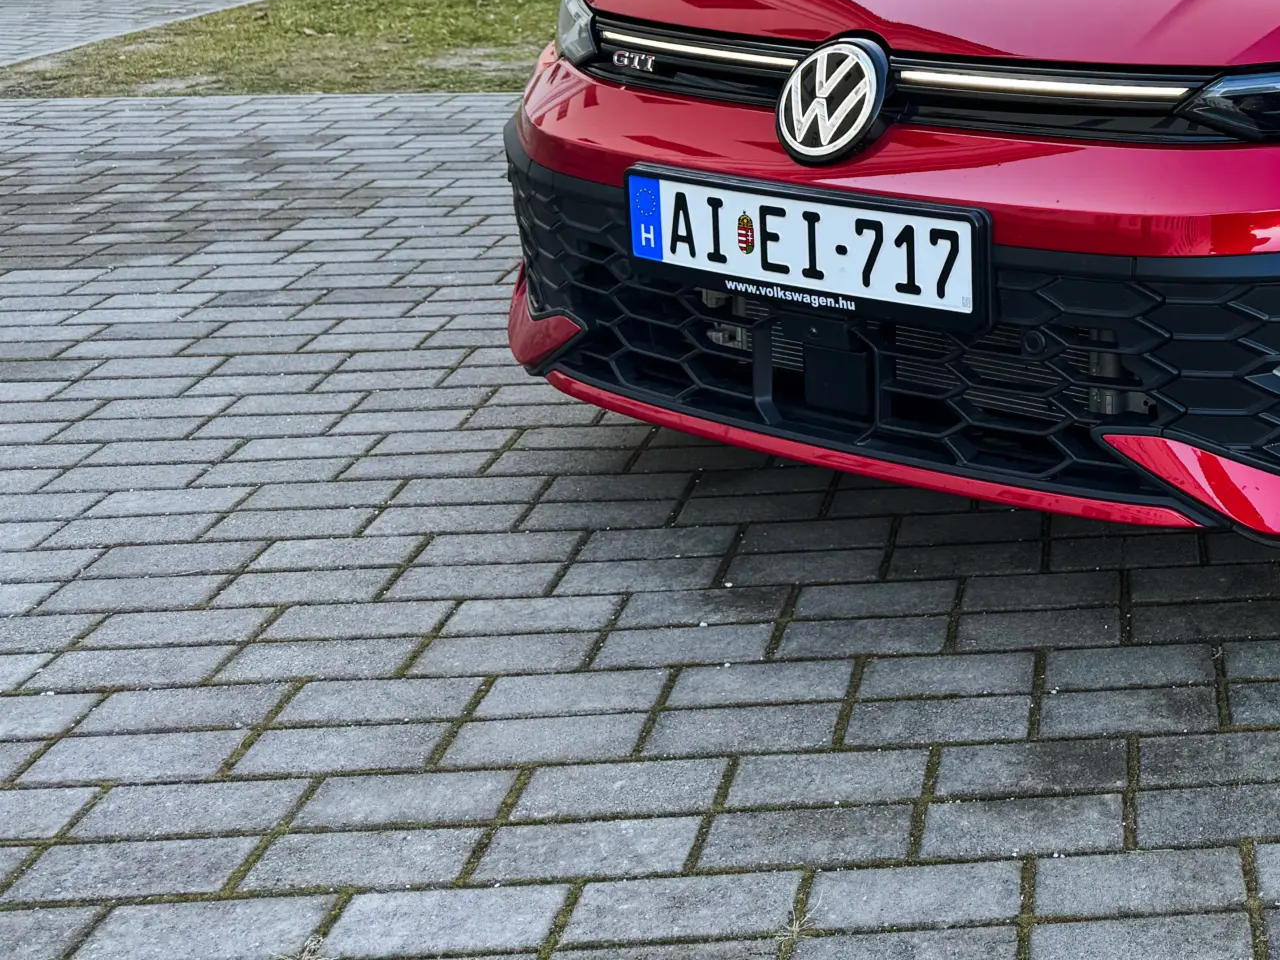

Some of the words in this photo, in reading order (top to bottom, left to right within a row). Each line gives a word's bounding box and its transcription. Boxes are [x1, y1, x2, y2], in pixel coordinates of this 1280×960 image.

[612, 50, 655, 72] GTI
[639, 223, 656, 248] H
[725, 278, 856, 311] www.volkswagen.hu
